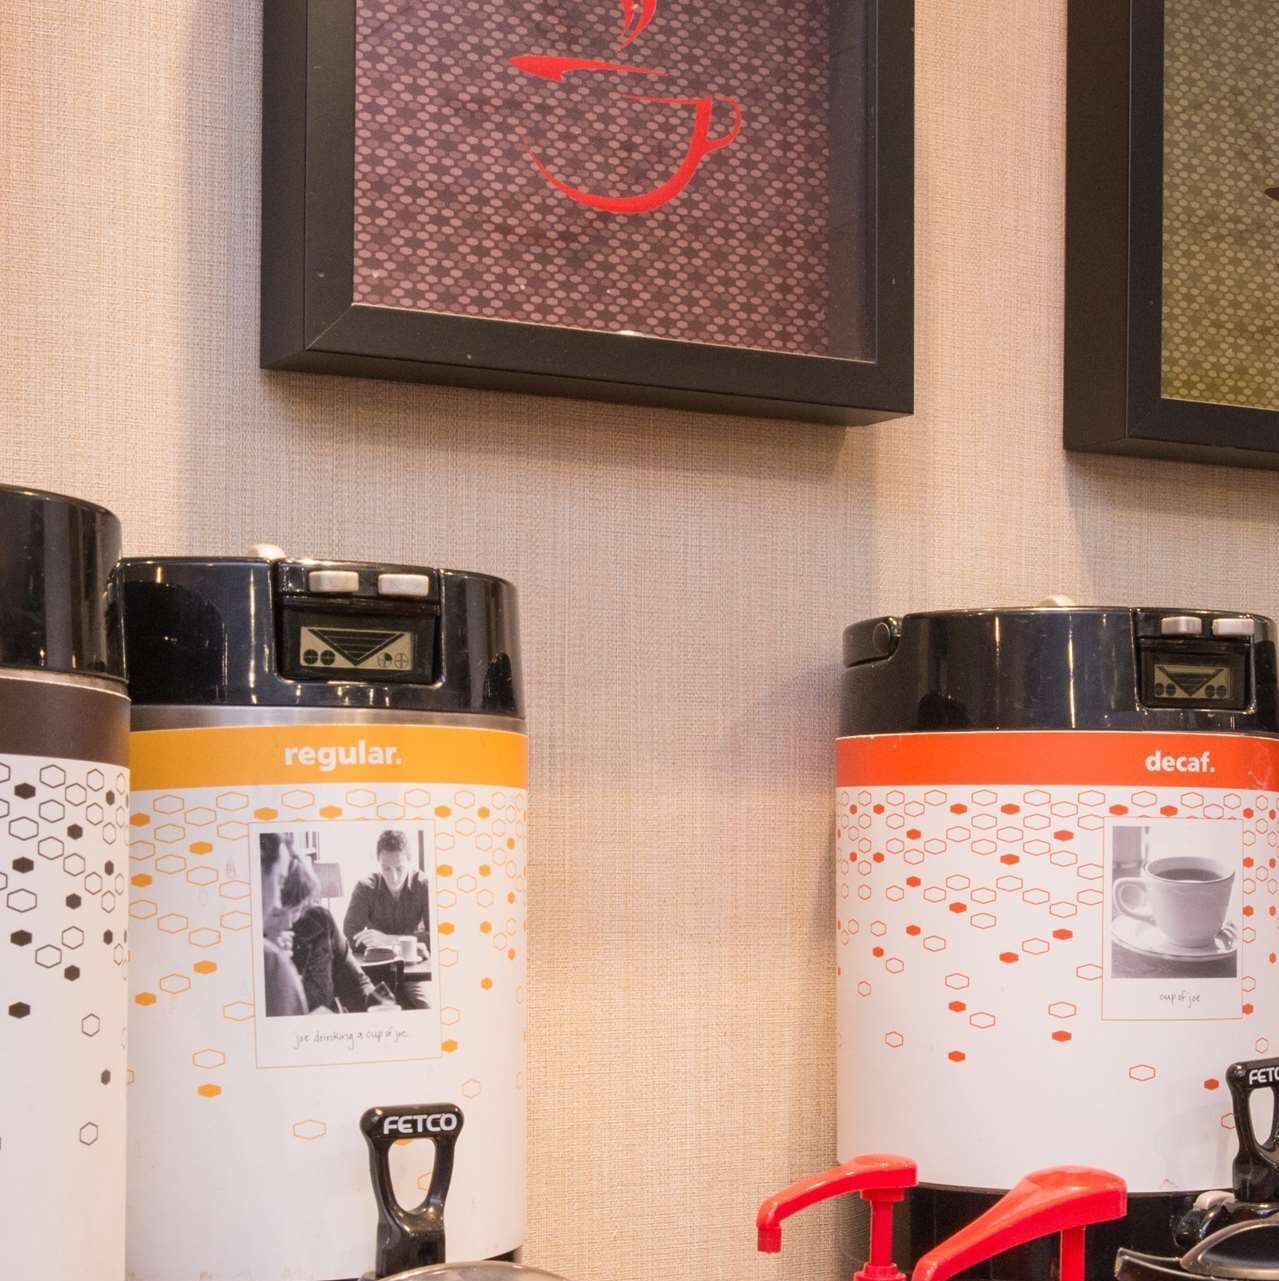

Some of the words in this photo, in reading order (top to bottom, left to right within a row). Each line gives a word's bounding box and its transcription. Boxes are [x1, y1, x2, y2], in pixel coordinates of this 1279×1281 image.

[284, 739, 402, 772] regular.
[1145, 751, 1216, 773] decaf.
[314, 1030, 355, 1050] drinking
[383, 1113, 458, 1135] FETCO
